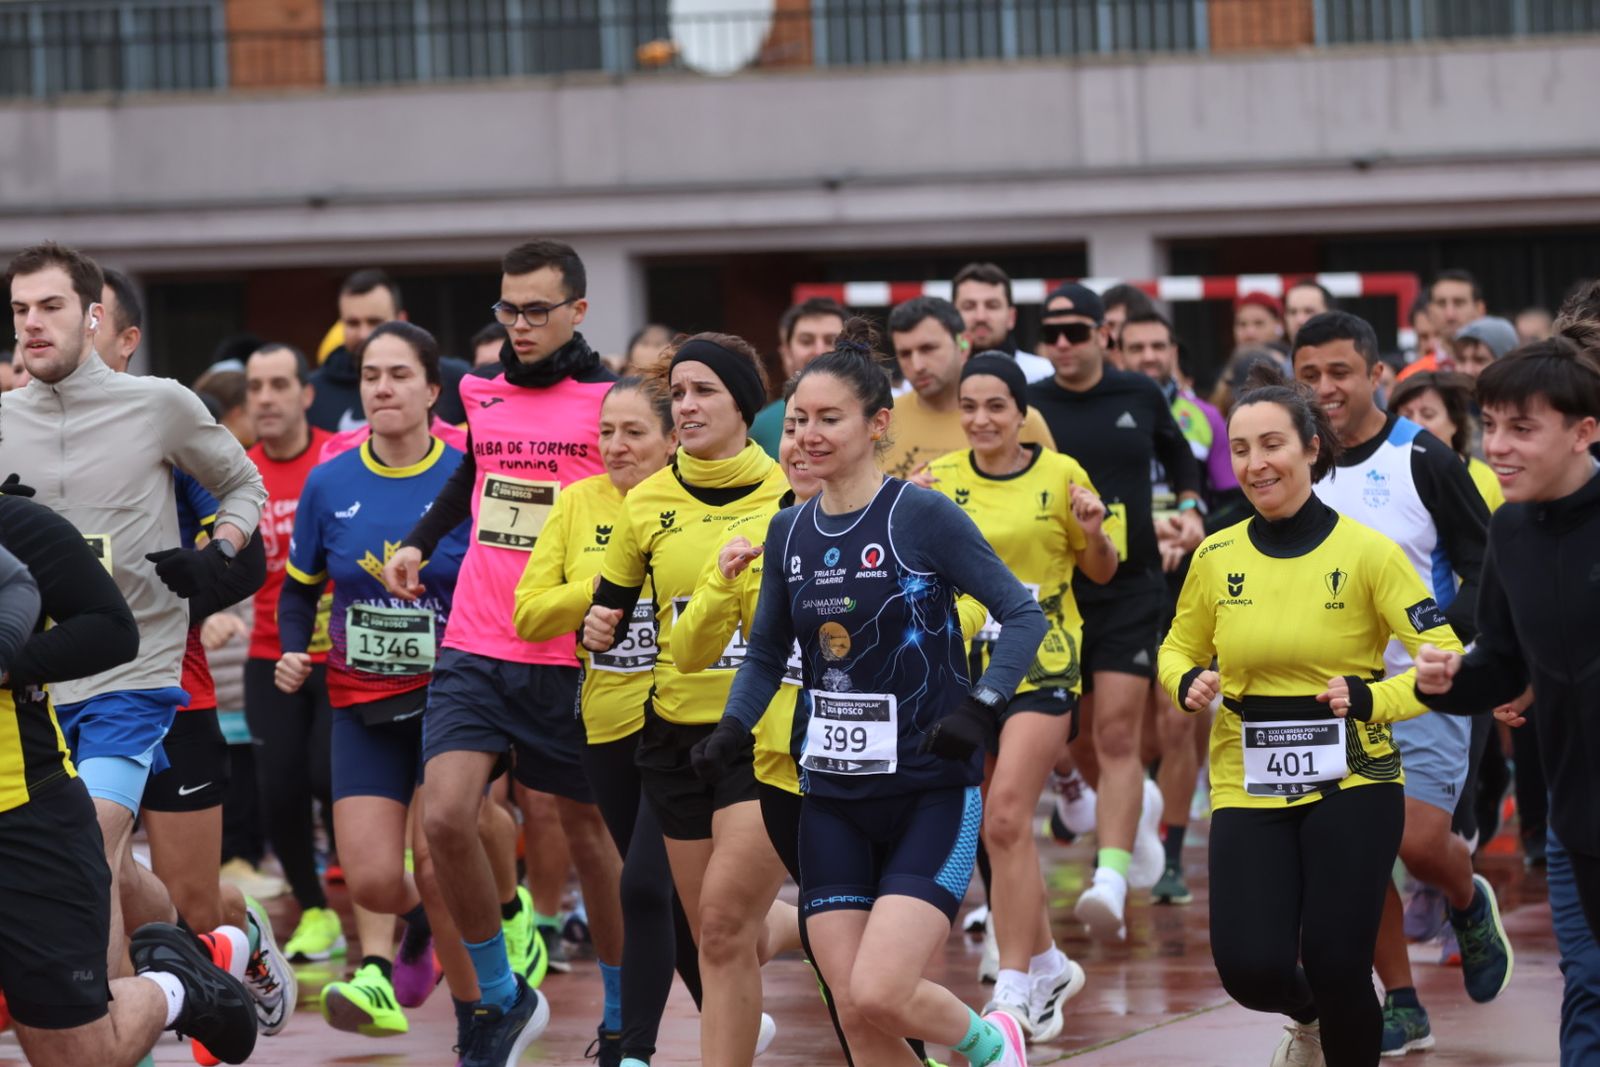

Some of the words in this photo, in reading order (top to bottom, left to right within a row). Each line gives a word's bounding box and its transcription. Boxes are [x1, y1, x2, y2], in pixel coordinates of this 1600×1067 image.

[475, 441, 502, 456] ALBA
[507, 441, 523, 455] DE
[529, 441, 588, 457] TORMES
[500, 459, 558, 473] running
[509, 506, 519, 528] 7
[1208, 539, 1235, 551] SPORT
[814, 568, 846, 577] TRIATLON
[815, 577, 844, 585] CHARRO
[816, 606, 848, 615] TELECOM
[1324, 602, 1345, 610] GCB
[633, 610, 648, 618] SCO
[621, 627, 654, 650] 58
[358, 633, 420, 658] 1346
[838, 707, 863, 715] BOSCO
[823, 725, 867, 753] 399
[1268, 734, 1285, 742] DON
[1286, 733, 1314, 741] BOSCO
[1266, 751, 1319, 777] 401
[811, 895, 875, 907] CHARRO
[72, 970, 94, 981] FILA
